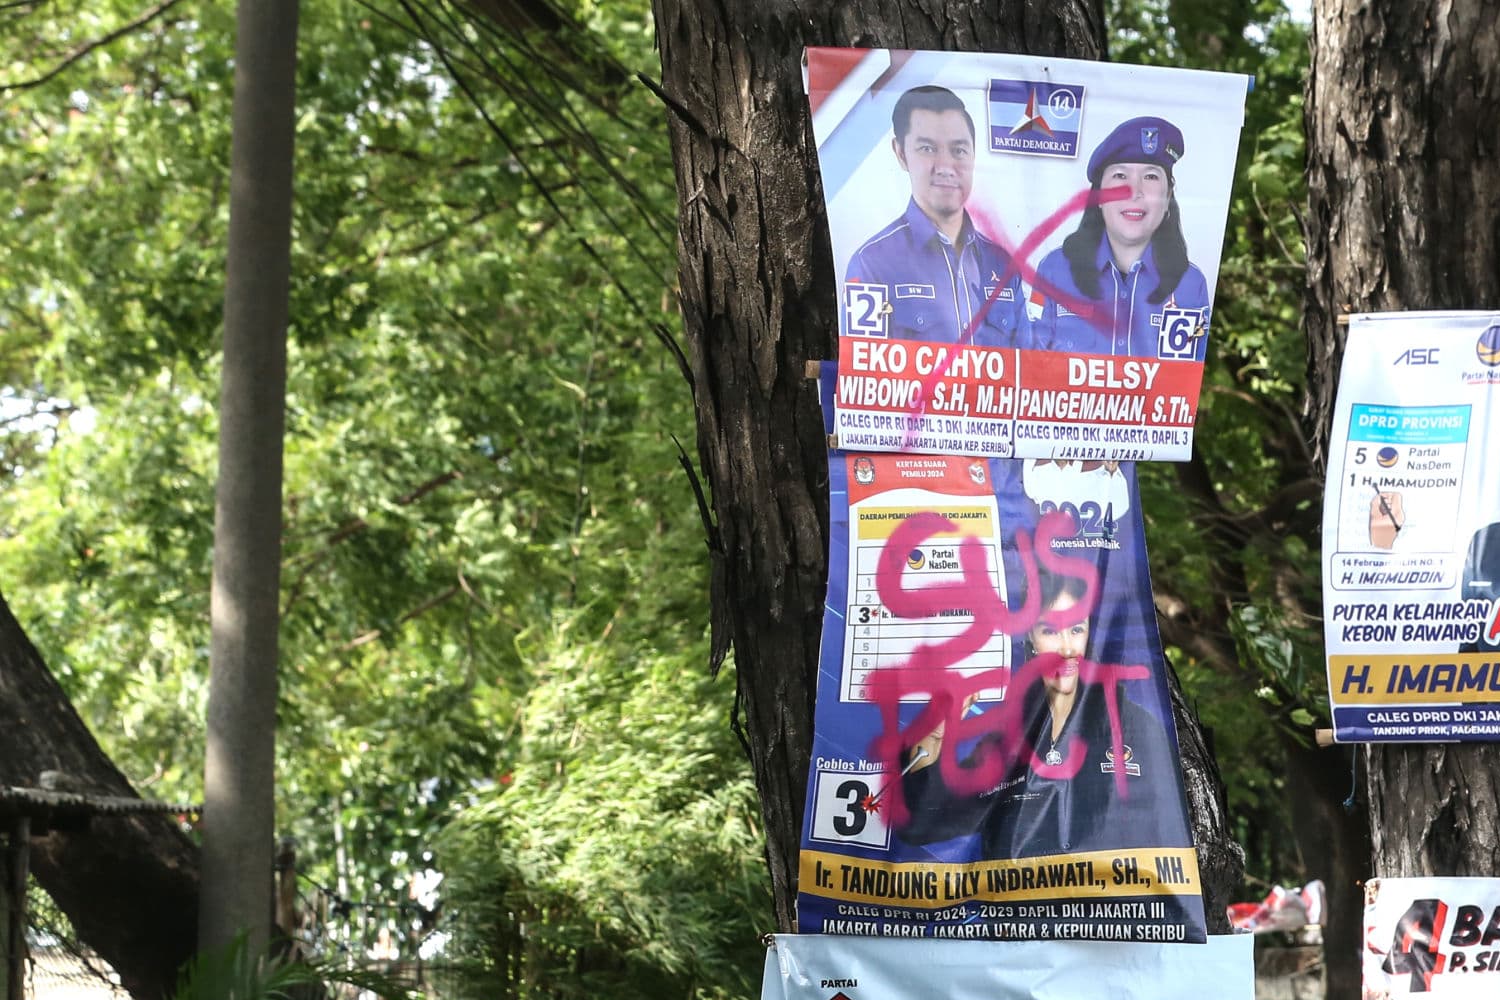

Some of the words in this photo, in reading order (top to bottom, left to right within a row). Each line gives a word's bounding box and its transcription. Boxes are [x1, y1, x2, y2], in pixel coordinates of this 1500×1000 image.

[1053, 96, 1070, 111] 14
[995, 137, 1022, 149] PARTAI
[1022, 139, 1071, 152] DEMOKRAT
[857, 293, 877, 327] 2
[1168, 319, 1189, 350] 6
[853, 341, 907, 373] EKO
[916, 346, 1004, 380] CAHYO
[1068, 358, 1160, 390] DELSY
[840, 375, 925, 414] WIBOWO,
[976, 385, 1014, 415] M.H
[1019, 389, 1147, 426] PANGEMANAN,
[1151, 395, 1193, 424] S.Th.
[840, 413, 871, 429] CALEG
[874, 415, 892, 430] DPR
[895, 417, 904, 431] RI
[907, 417, 934, 433] DAPIL
[937, 419, 943, 433] 3
[946, 420, 962, 435] DKI
[965, 420, 1009, 437] JAKARTA
[1359, 415, 1398, 428] DPRD
[1402, 416, 1463, 429] PROVINSI
[1016, 424, 1050, 440] CALEG
[1053, 426, 1079, 441] DPRD
[1082, 427, 1100, 442] DKI
[1103, 428, 1149, 444] JAKARTA
[1152, 430, 1180, 445] DAPIL
[1182, 431, 1188, 445] 3
[904, 437, 937, 450] JAKARTA
[939, 440, 963, 450] UTARA
[964, 441, 980, 451] KEP.
[1409, 448, 1440, 457] Partai
[1060, 447, 1105, 458] JAKARTA
[1112, 449, 1144, 459] UTARA
[1355, 448, 1367, 464] 5
[1407, 460, 1451, 470] NasDem
[1379, 477, 1457, 487] IMAMUDDIN
[932, 549, 954, 559] Partai
[929, 560, 958, 570] NasDem
[1341, 571, 1354, 584] H.
[1359, 571, 1443, 584] IMAMUDDIN
[859, 607, 870, 623] 3
[1333, 603, 1387, 621] PUTRA
[1393, 602, 1489, 621] KELAHIRAN
[1342, 624, 1398, 642] KEBON
[1402, 623, 1478, 641] BAWANG
[1341, 665, 1374, 693] H.
[1367, 712, 1410, 723] CALEG
[1413, 712, 1450, 722] DPRD
[1453, 711, 1476, 722] DKI
[1372, 726, 1416, 736] TANJUNG
[816, 757, 855, 770] Coblos
[832, 779, 869, 837] 3
[816, 861, 833, 889] Ir.
[841, 864, 937, 900] TANDJUNG
[944, 870, 980, 900] LILY
[1155, 856, 1190, 884] MH.
[838, 904, 879, 918] CALEG
[884, 908, 911, 919] DPR
[916, 911, 929, 921] RI
[934, 905, 967, 921] 2024
[980, 904, 1013, 918] 2029
[1018, 906, 1057, 918] DAPIL
[1062, 904, 1085, 918] DKI
[1089, 903, 1146, 918] JAKARTA
[1151, 902, 1165, 918] III
[822, 919, 878, 936] JAKARTA
[933, 924, 990, 938] JAKARTA
[994, 923, 1036, 938] UTARA
[1041, 925, 1049, 938] &
[1054, 924, 1132, 940] KEPULAUAN
[1136, 924, 1185, 941] SERIBU
[1381, 899, 1449, 992] 4
[1448, 951, 1468, 973] P.
[821, 979, 857, 988] PARTAI
